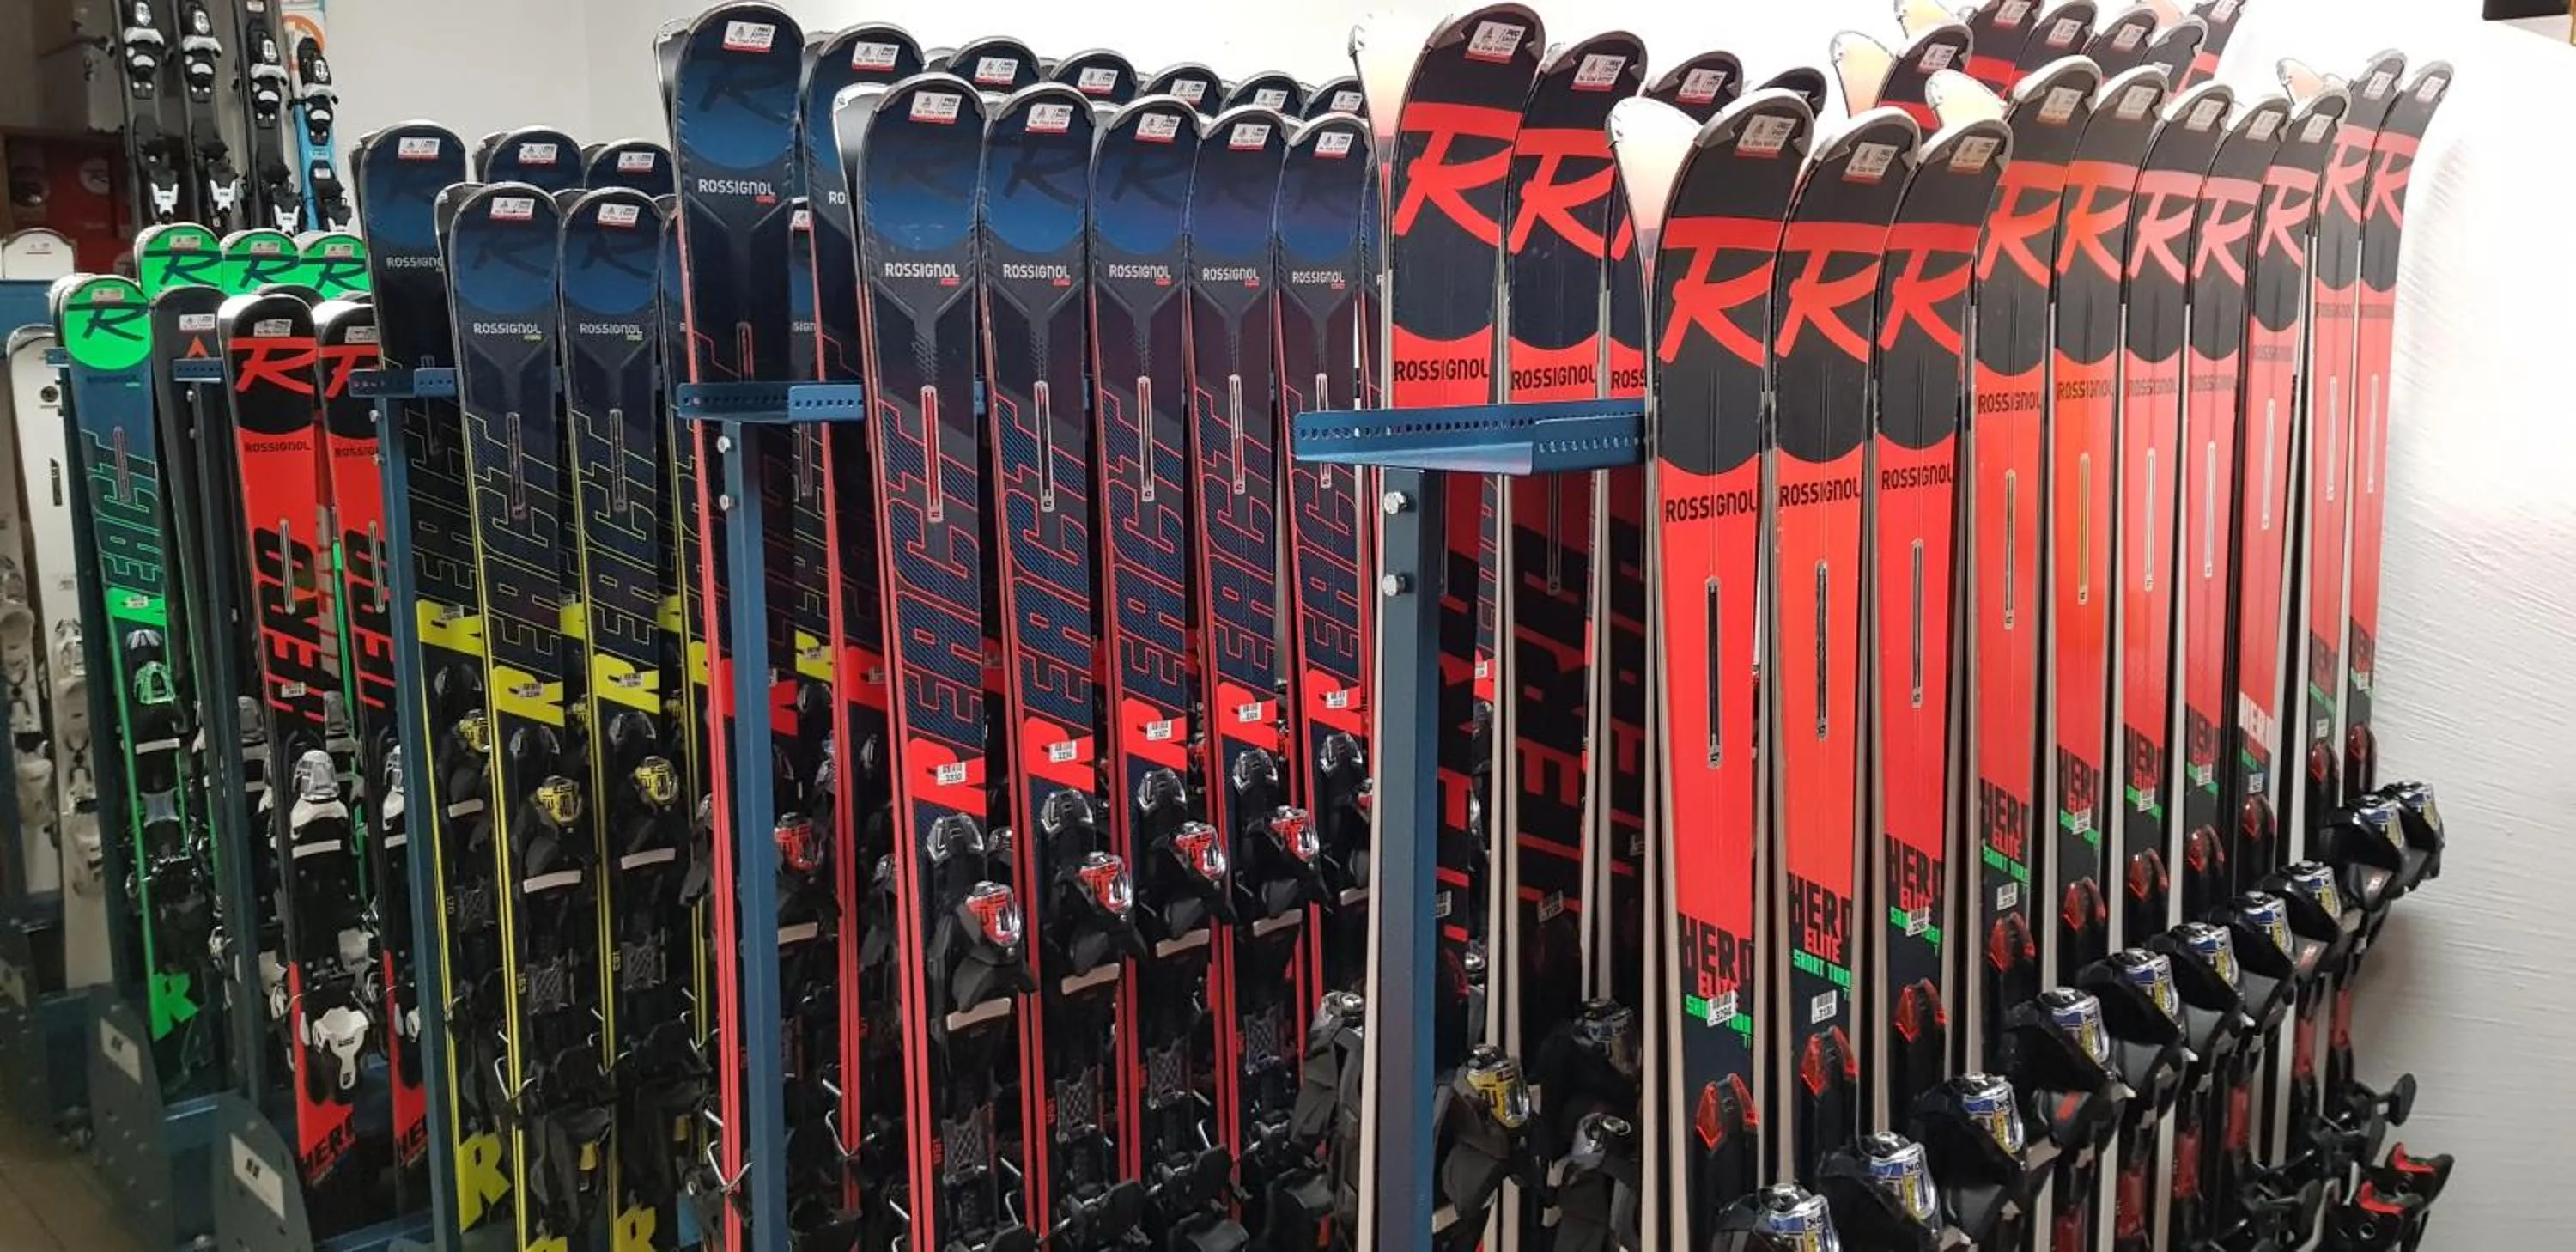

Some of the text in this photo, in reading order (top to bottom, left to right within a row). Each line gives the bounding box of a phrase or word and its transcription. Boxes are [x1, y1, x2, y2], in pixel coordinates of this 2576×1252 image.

[698, 178, 775, 196] ROSSIGNOL
[1393, 102, 1521, 247] R
[1978, 161, 2067, 288] R
[2057, 161, 2144, 283] R
[2128, 170, 2205, 286] R
[2193, 174, 2262, 286] R
[2258, 166, 2320, 266] R
[143, 250, 222, 286] R
[226, 254, 299, 289] R
[299, 258, 365, 291] R
[386, 257, 444, 268] ROSSIGNO
[884, 262, 961, 279] ROSSIGNOL
[1003, 263, 1072, 280] ROSSIGNOL
[1109, 263, 1172, 280] ROSSIGNOL
[1203, 266, 1261, 283] ROSSIGNOL
[1292, 270, 1346, 284] ROSSIGNOL
[1659, 216, 1781, 368] R
[1775, 222, 1888, 362] R
[1880, 223, 1979, 357] R
[68, 301, 148, 341] R
[474, 322, 542, 335] ROSSIGNOL
[580, 323, 643, 336] ROSSIGNOL
[231, 337, 318, 395] R
[1394, 357, 1489, 385] ROSSIGNOL
[1510, 362, 1597, 391] ROSSIGNOL
[1978, 392, 2043, 415] ROSSIGNOL
[2057, 377, 2114, 402] ROSSIGNOL
[245, 440, 312, 453] ROSSIGNOL
[1779, 475, 1862, 508] ROSSIGNOL
[1880, 461, 1953, 490] ROSSIGNOL
[1665, 488, 1759, 526] ROSSIGNOL
[1992, 826, 2021, 860] ELITE
[1788, 872, 1852, 944] HERO
[1805, 927, 1842, 963] ELITE
[1793, 948, 1825, 977] SHORT
[150, 971, 199, 1042] R
[459, 1132, 511, 1234] R
